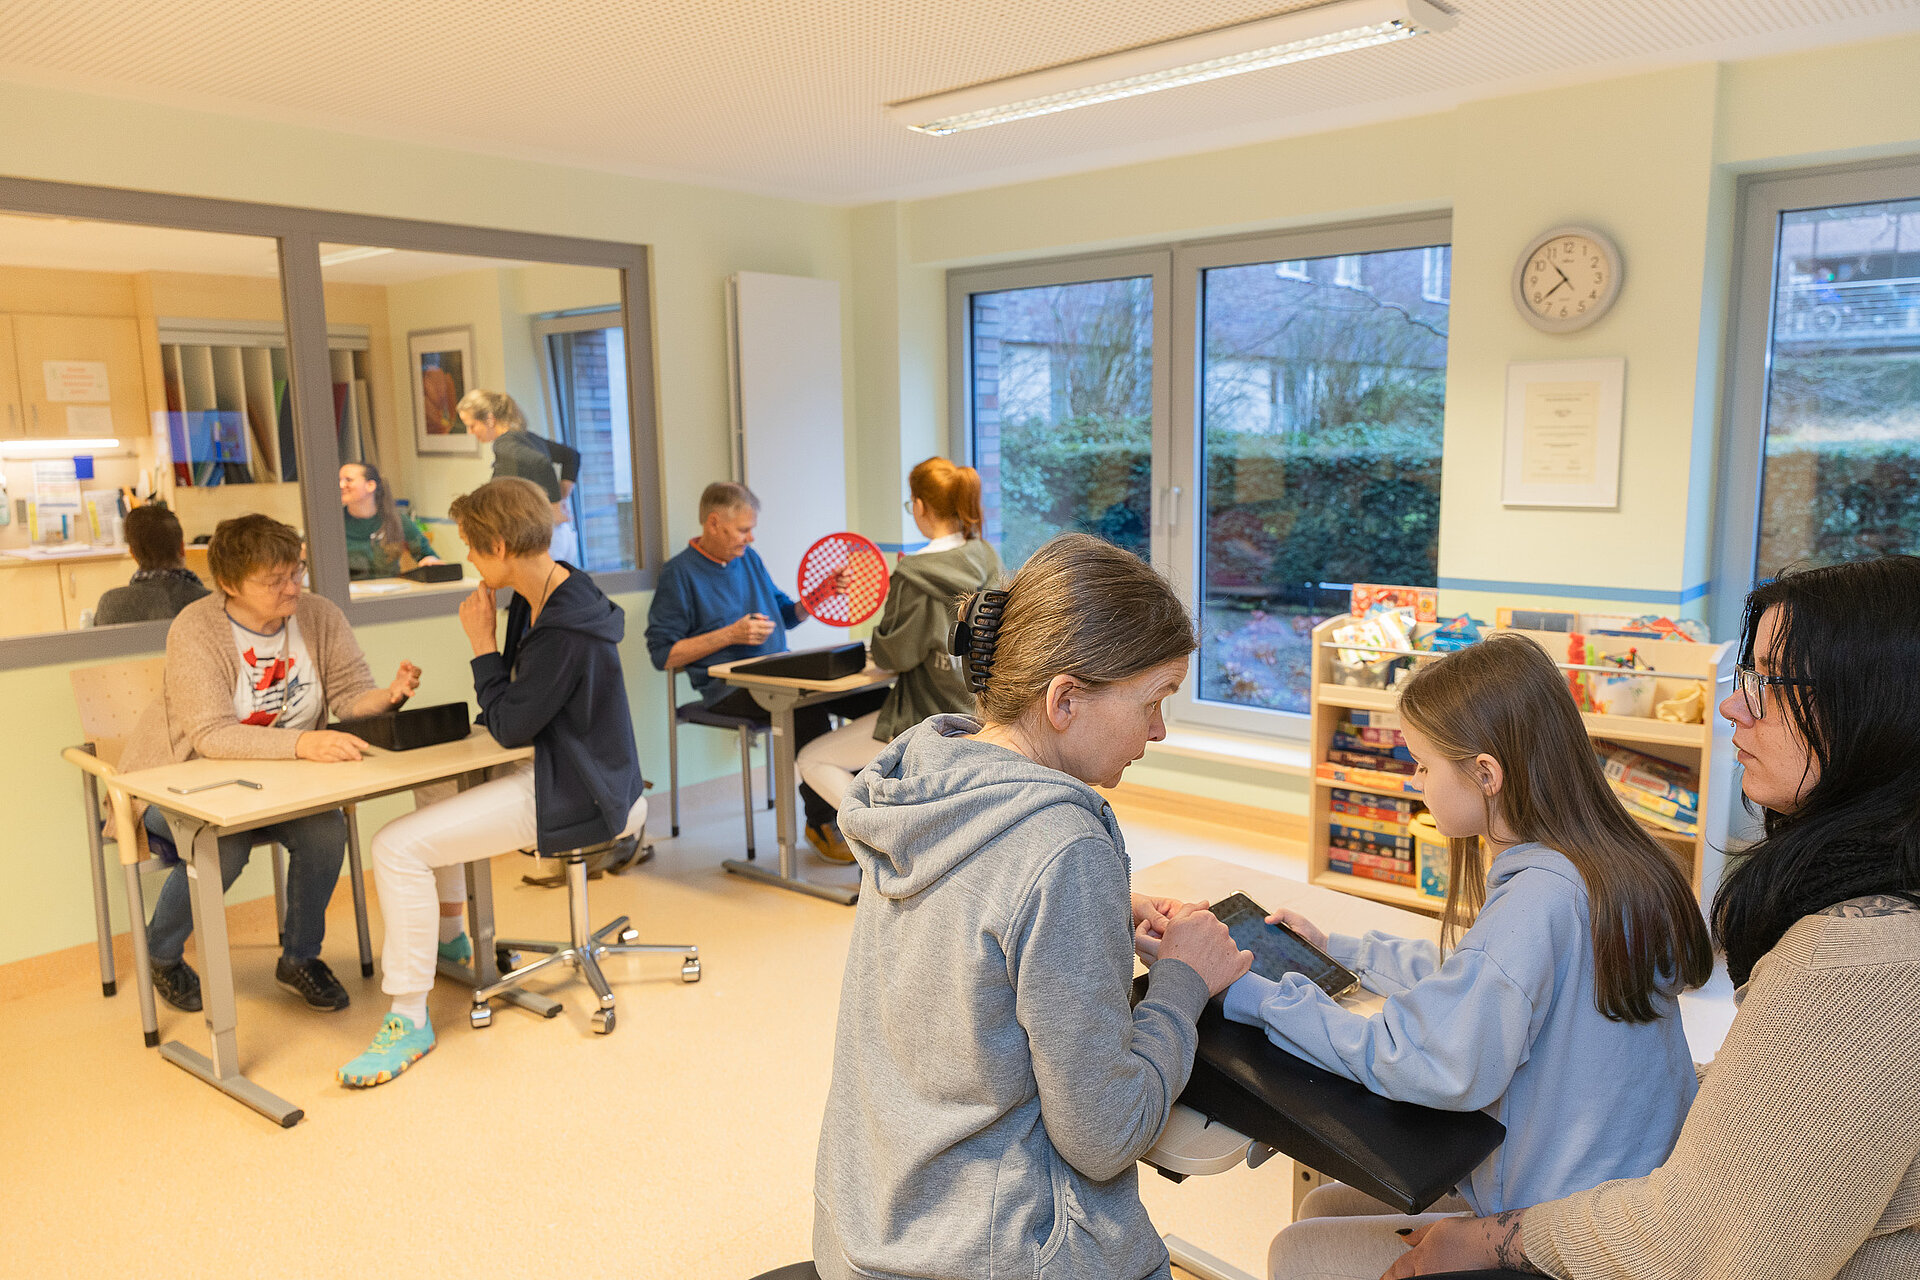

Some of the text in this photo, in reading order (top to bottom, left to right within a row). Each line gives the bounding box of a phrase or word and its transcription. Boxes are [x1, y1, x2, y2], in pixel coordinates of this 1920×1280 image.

[1547, 247, 1557, 259] 11
[1563, 241, 1575, 253] 12
[1535, 260, 1546, 272] 10
[1591, 256, 1599, 268] 2
[1594, 272, 1602, 284] 3
[1534, 292, 1542, 304] 8
[1545, 302, 1553, 313] 7
[1560, 306, 1568, 317] 6
[1577, 301, 1586, 312] 5
